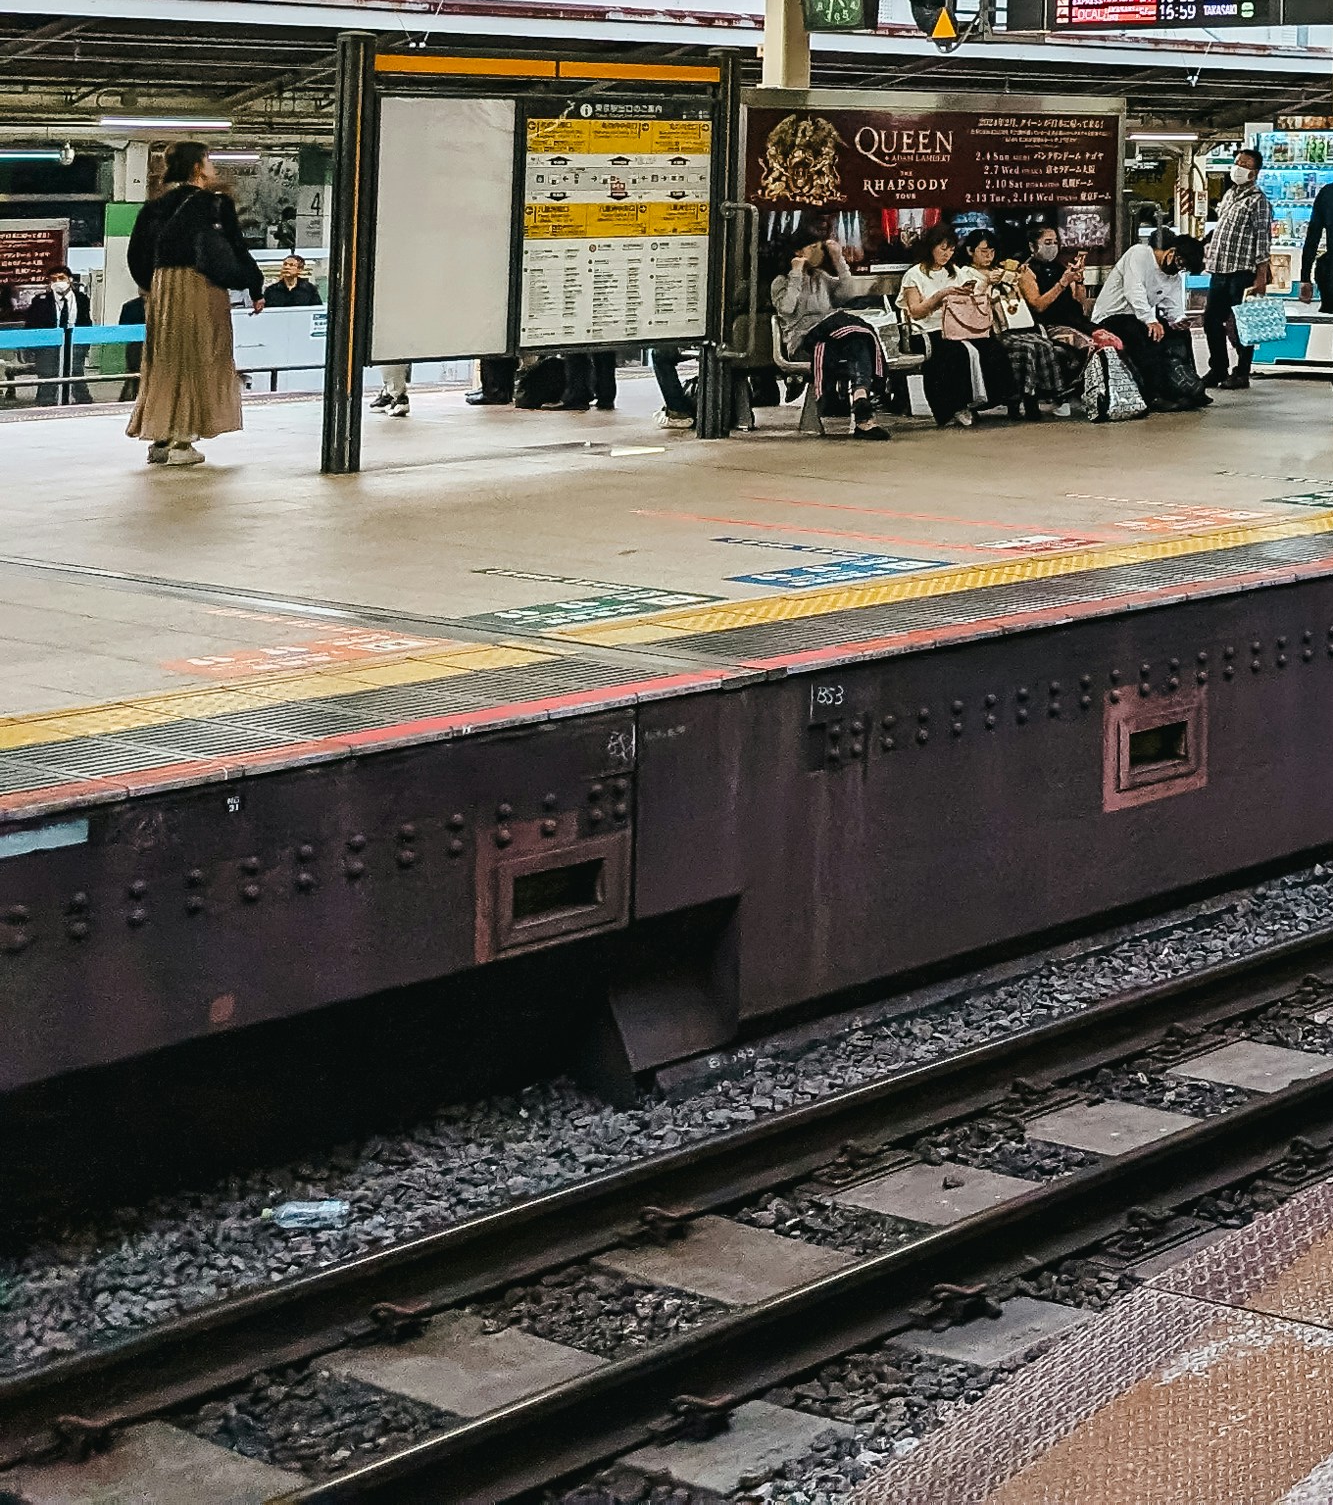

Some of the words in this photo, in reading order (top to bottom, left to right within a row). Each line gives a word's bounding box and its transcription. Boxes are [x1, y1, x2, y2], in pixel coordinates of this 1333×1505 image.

[1160, 5, 1197, 20] 16:59
[1203, 5, 1238, 16] TAKASAKI
[855, 126, 953, 167] QUEEN
[976, 152, 991, 161] 2.4
[993, 151, 1010, 161] Sun
[984, 165, 999, 174] 2.7
[1001, 165, 1020, 175] Wed
[863, 179, 949, 197] RHAPSODY
[985, 179, 1007, 189] 2.10
[1008, 179, 1023, 188] Sat
[311, 192, 322, 215] 4
[965, 193, 987, 203] 2.13
[1036, 192, 1054, 202] Wed
